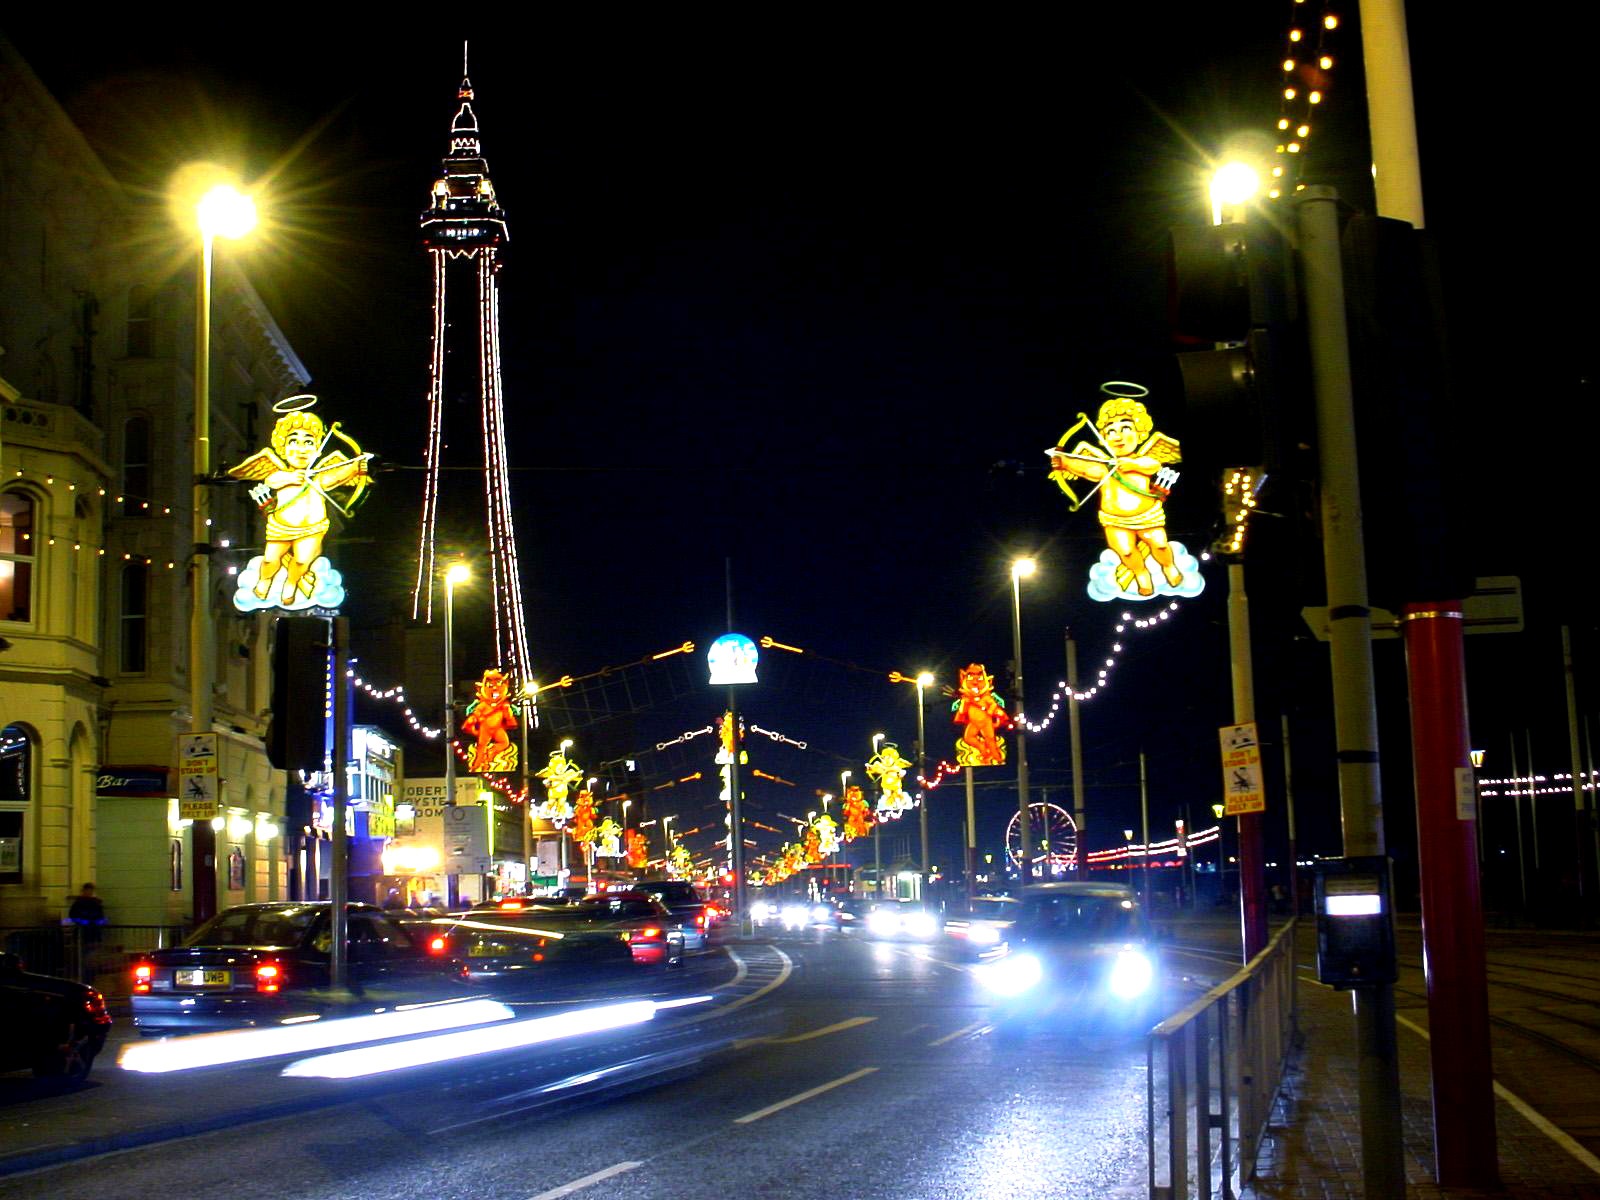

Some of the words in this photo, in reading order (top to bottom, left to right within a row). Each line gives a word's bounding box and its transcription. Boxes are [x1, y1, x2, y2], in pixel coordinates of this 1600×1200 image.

[180, 767, 204, 775] STAND
[206, 767, 217, 775] UP
[97, 775, 133, 789] Bar
